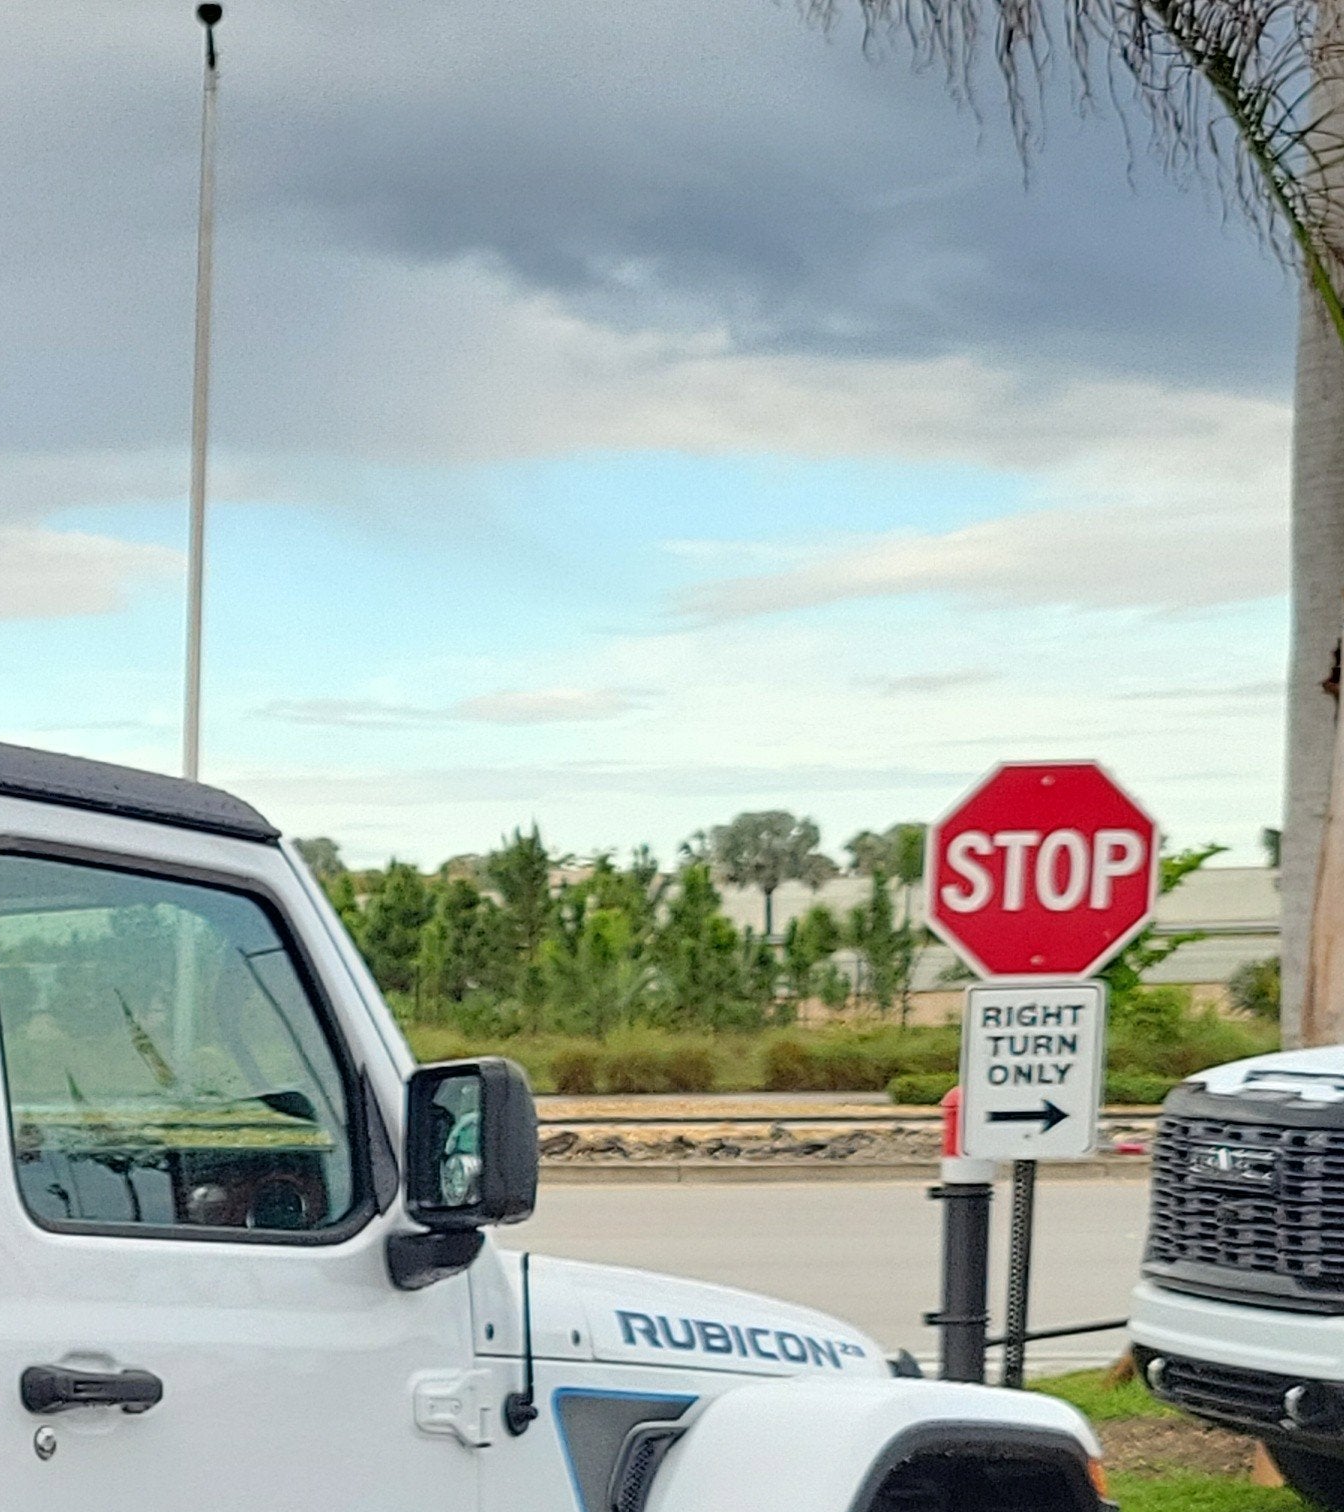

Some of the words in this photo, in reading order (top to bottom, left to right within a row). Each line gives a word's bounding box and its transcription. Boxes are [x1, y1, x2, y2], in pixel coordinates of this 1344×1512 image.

[940, 828, 1146, 913] STOP
[981, 1004, 1085, 1027] RIGHT
[986, 1033, 1077, 1056] TURN
[988, 1063, 1073, 1085] ONLY
[615, 1310, 843, 1369] RUBICON
